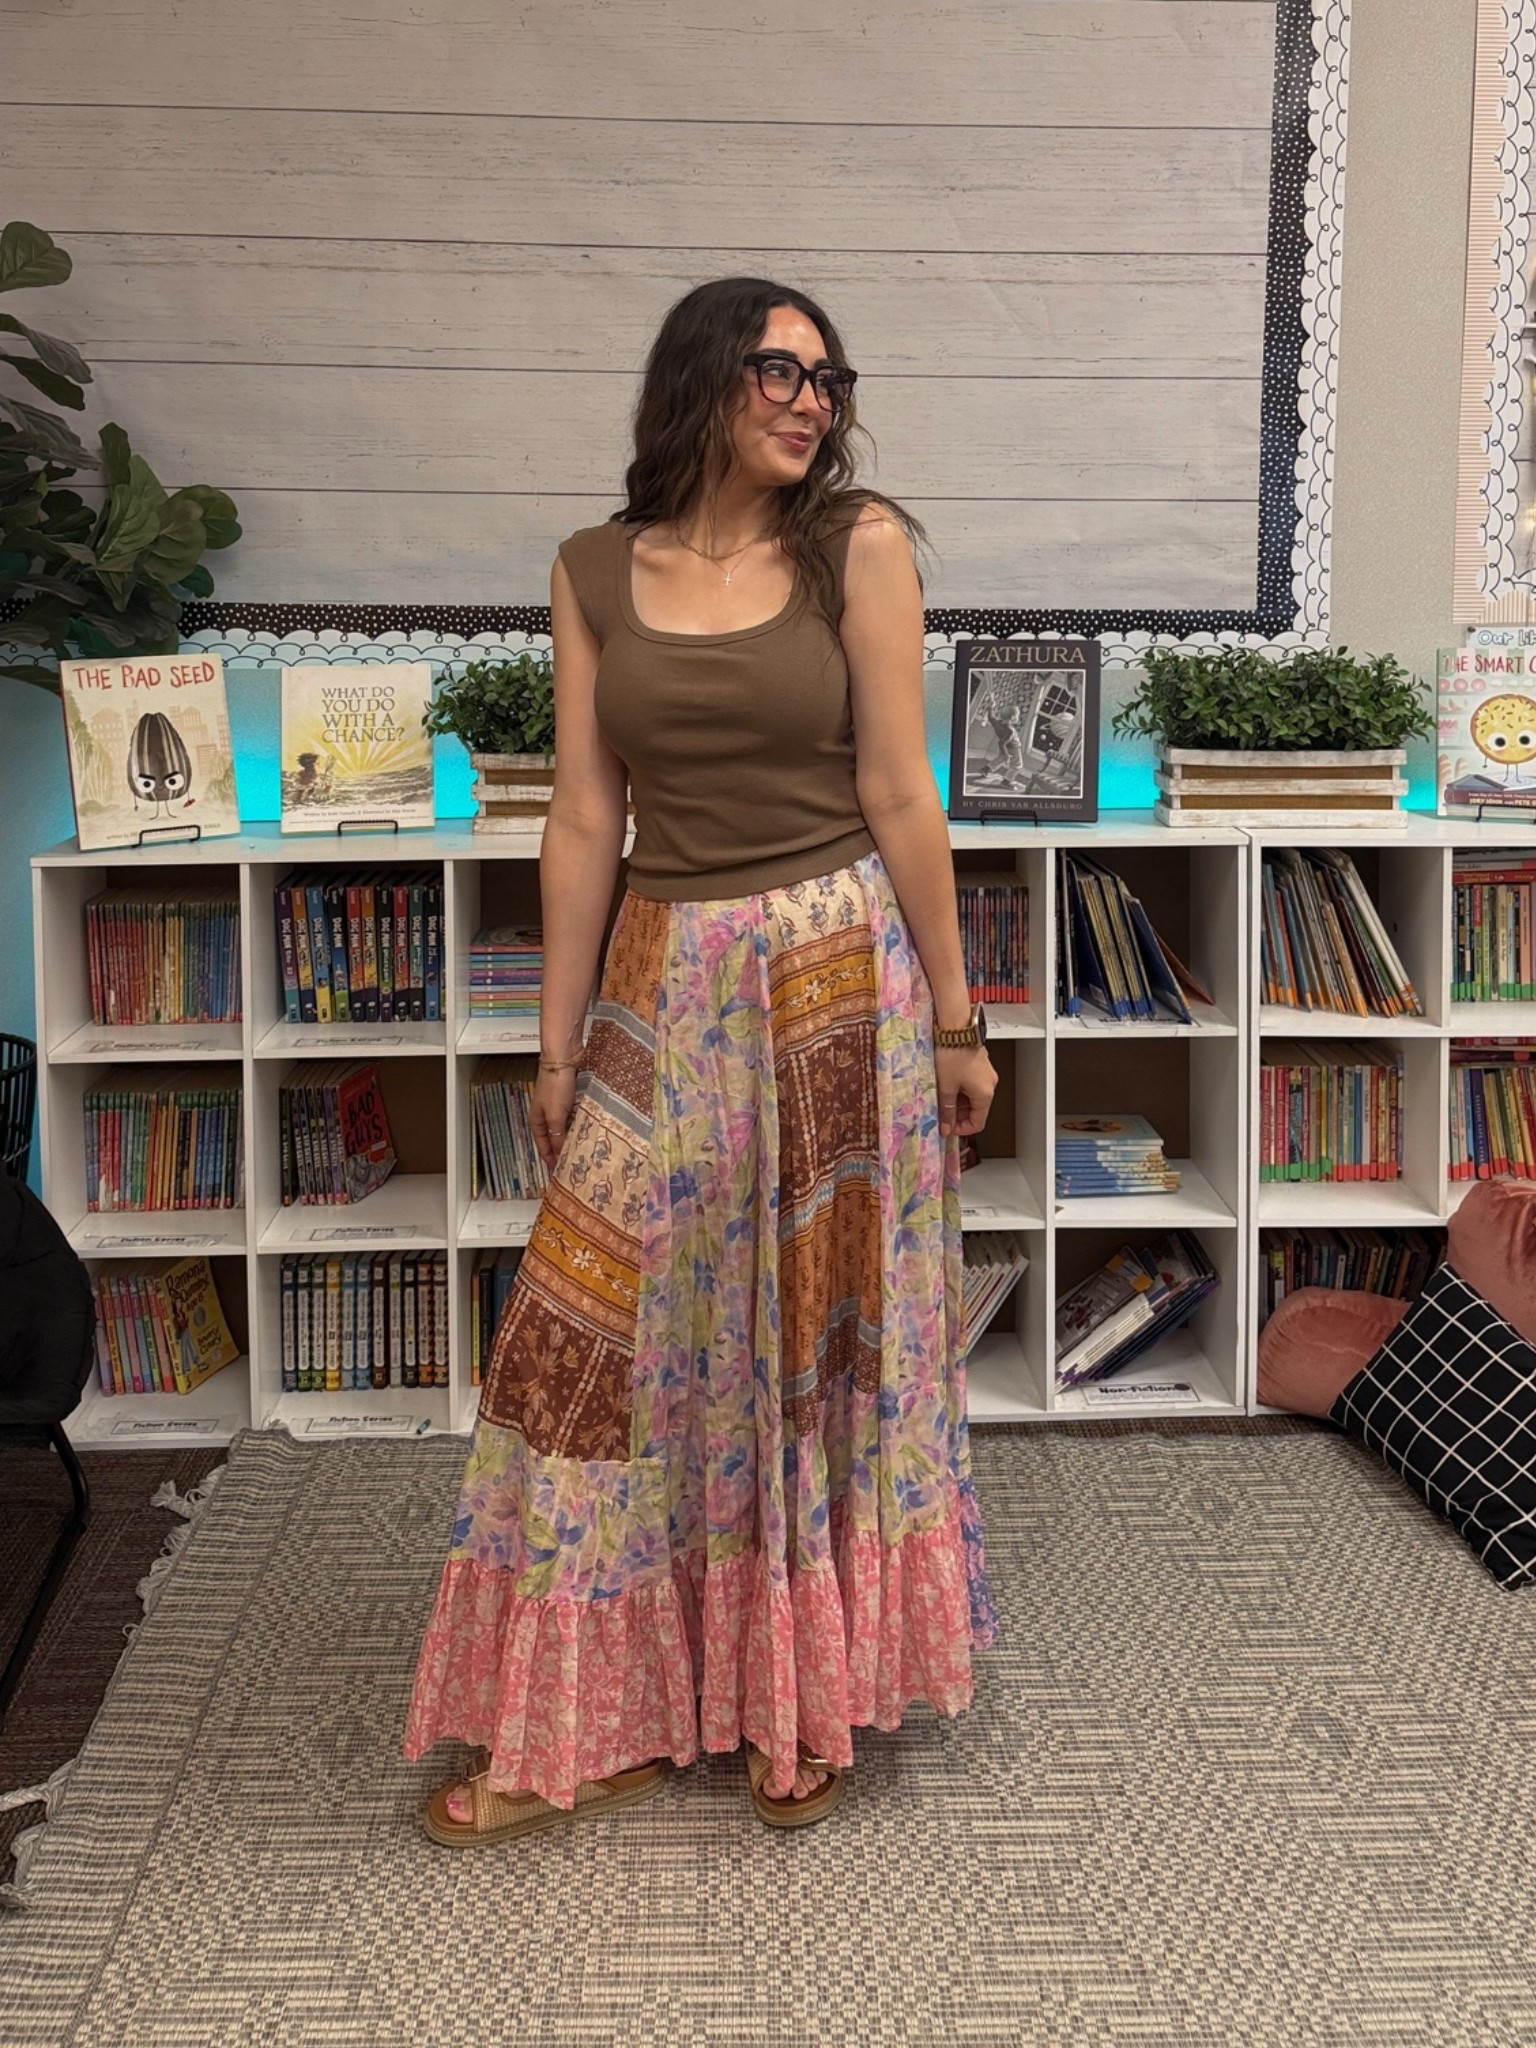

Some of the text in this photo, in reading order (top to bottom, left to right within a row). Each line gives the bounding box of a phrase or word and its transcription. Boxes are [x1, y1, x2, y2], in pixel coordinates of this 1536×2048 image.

[1478, 630, 1514, 646] Our
[970, 646, 1086, 664] ZATHURA
[1475, 654, 1524, 674] SMART
[72, 662, 214, 690] THE BAD SEED
[322, 686, 394, 698] WHAT DO
[322, 698, 395, 713] YOU DO
[322, 713, 395, 728] WITH A
[322, 728, 405, 744] CHANCE?
[348, 1090, 375, 1127] BAD
[344, 1112, 384, 1158] GUYS
[166, 1260, 206, 1296] Ramona
[186, 1293, 204, 1312] Age 8
[196, 1325, 220, 1344] Beverly
[199, 1335, 222, 1356] Cleary
